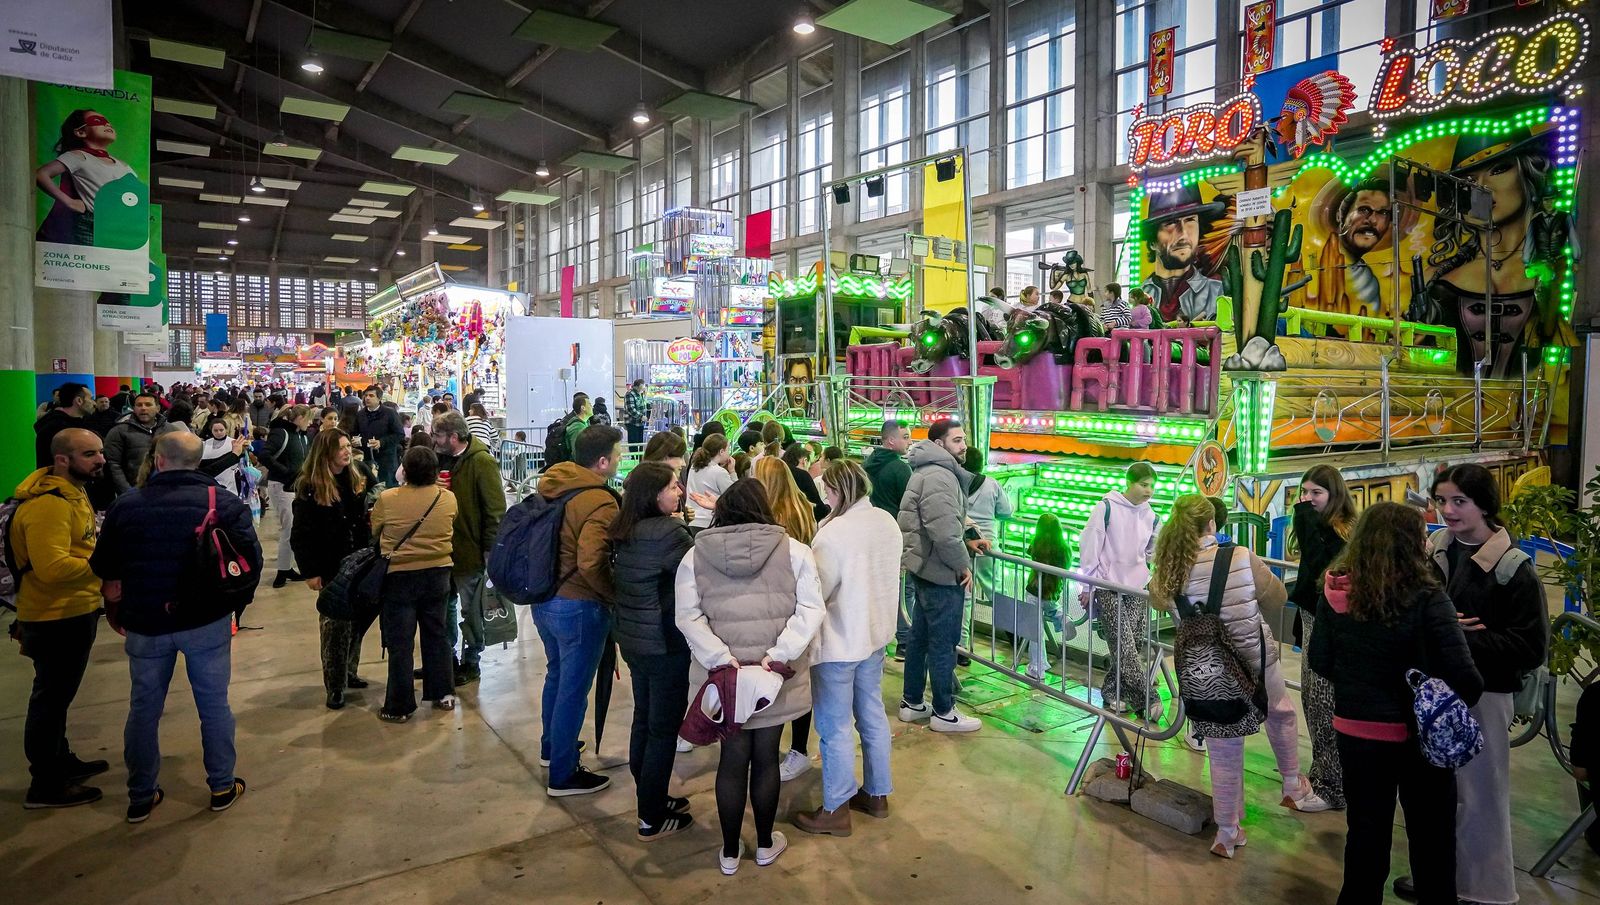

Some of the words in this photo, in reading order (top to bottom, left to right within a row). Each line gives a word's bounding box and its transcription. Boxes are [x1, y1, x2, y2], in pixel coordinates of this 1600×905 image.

[1152, 32, 1171, 48] TORO
[40, 42, 80, 55] Diputación
[1377, 21, 1578, 111] LOCO
[1150, 71, 1169, 93] LOCO
[1133, 100, 1255, 165] TORO
[43, 252, 70, 260] ZONA
[43, 260, 111, 271] ATRACCIONES
[670, 344, 701, 353] MAGIC
[679, 352, 692, 361] POL
